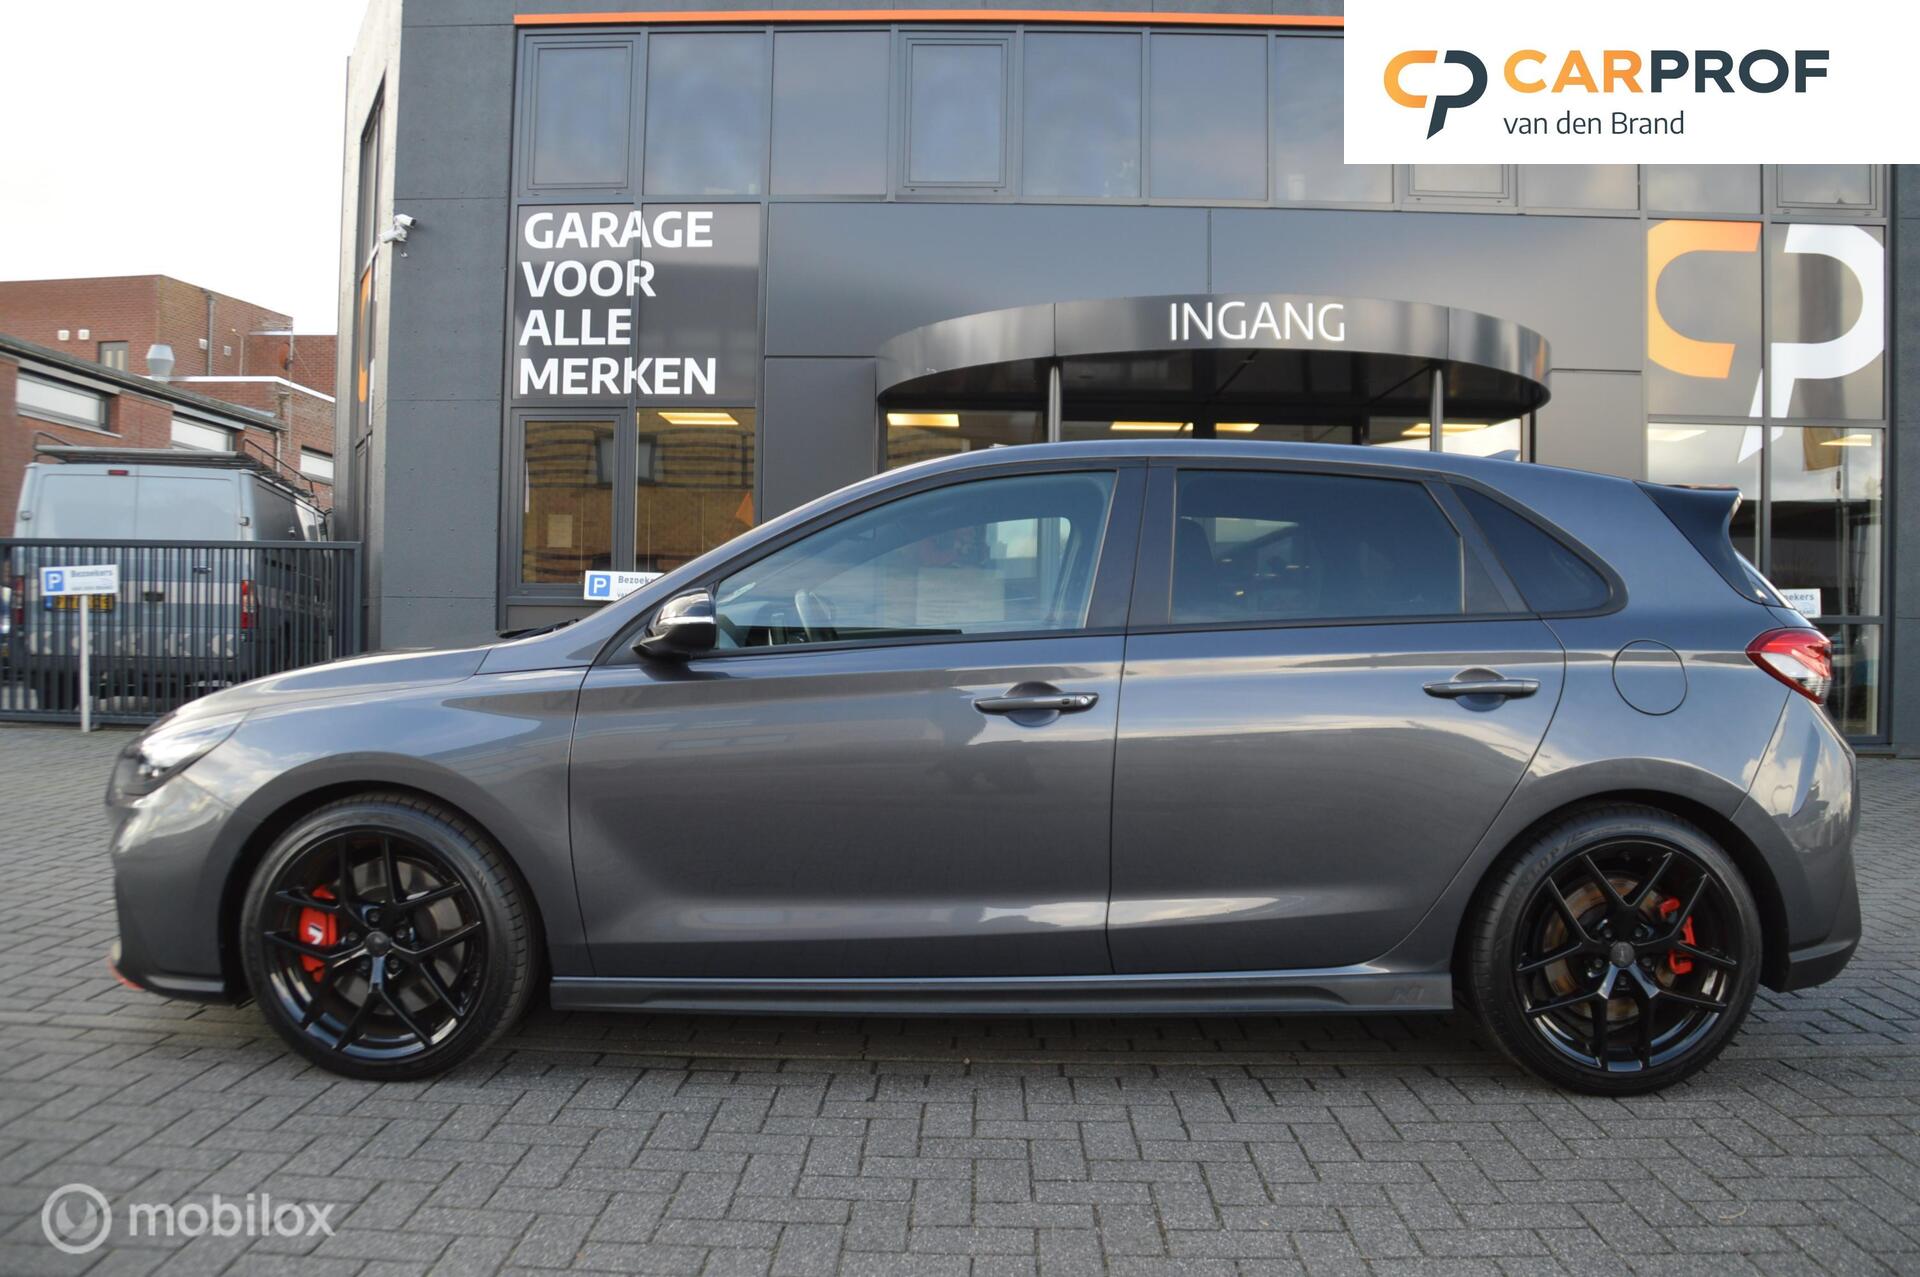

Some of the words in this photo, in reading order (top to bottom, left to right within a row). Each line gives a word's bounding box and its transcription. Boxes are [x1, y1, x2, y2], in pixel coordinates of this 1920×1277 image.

[524, 211, 713, 248] GARAGE
[521, 259, 656, 297] VOOR
[519, 309, 631, 345] ALLE
[1170, 301, 1345, 341] INGANG
[520, 357, 716, 394] MERKEN
[47, 573, 62, 590] P
[593, 577, 607, 594] P
[618, 575, 655, 584] Bezoek
